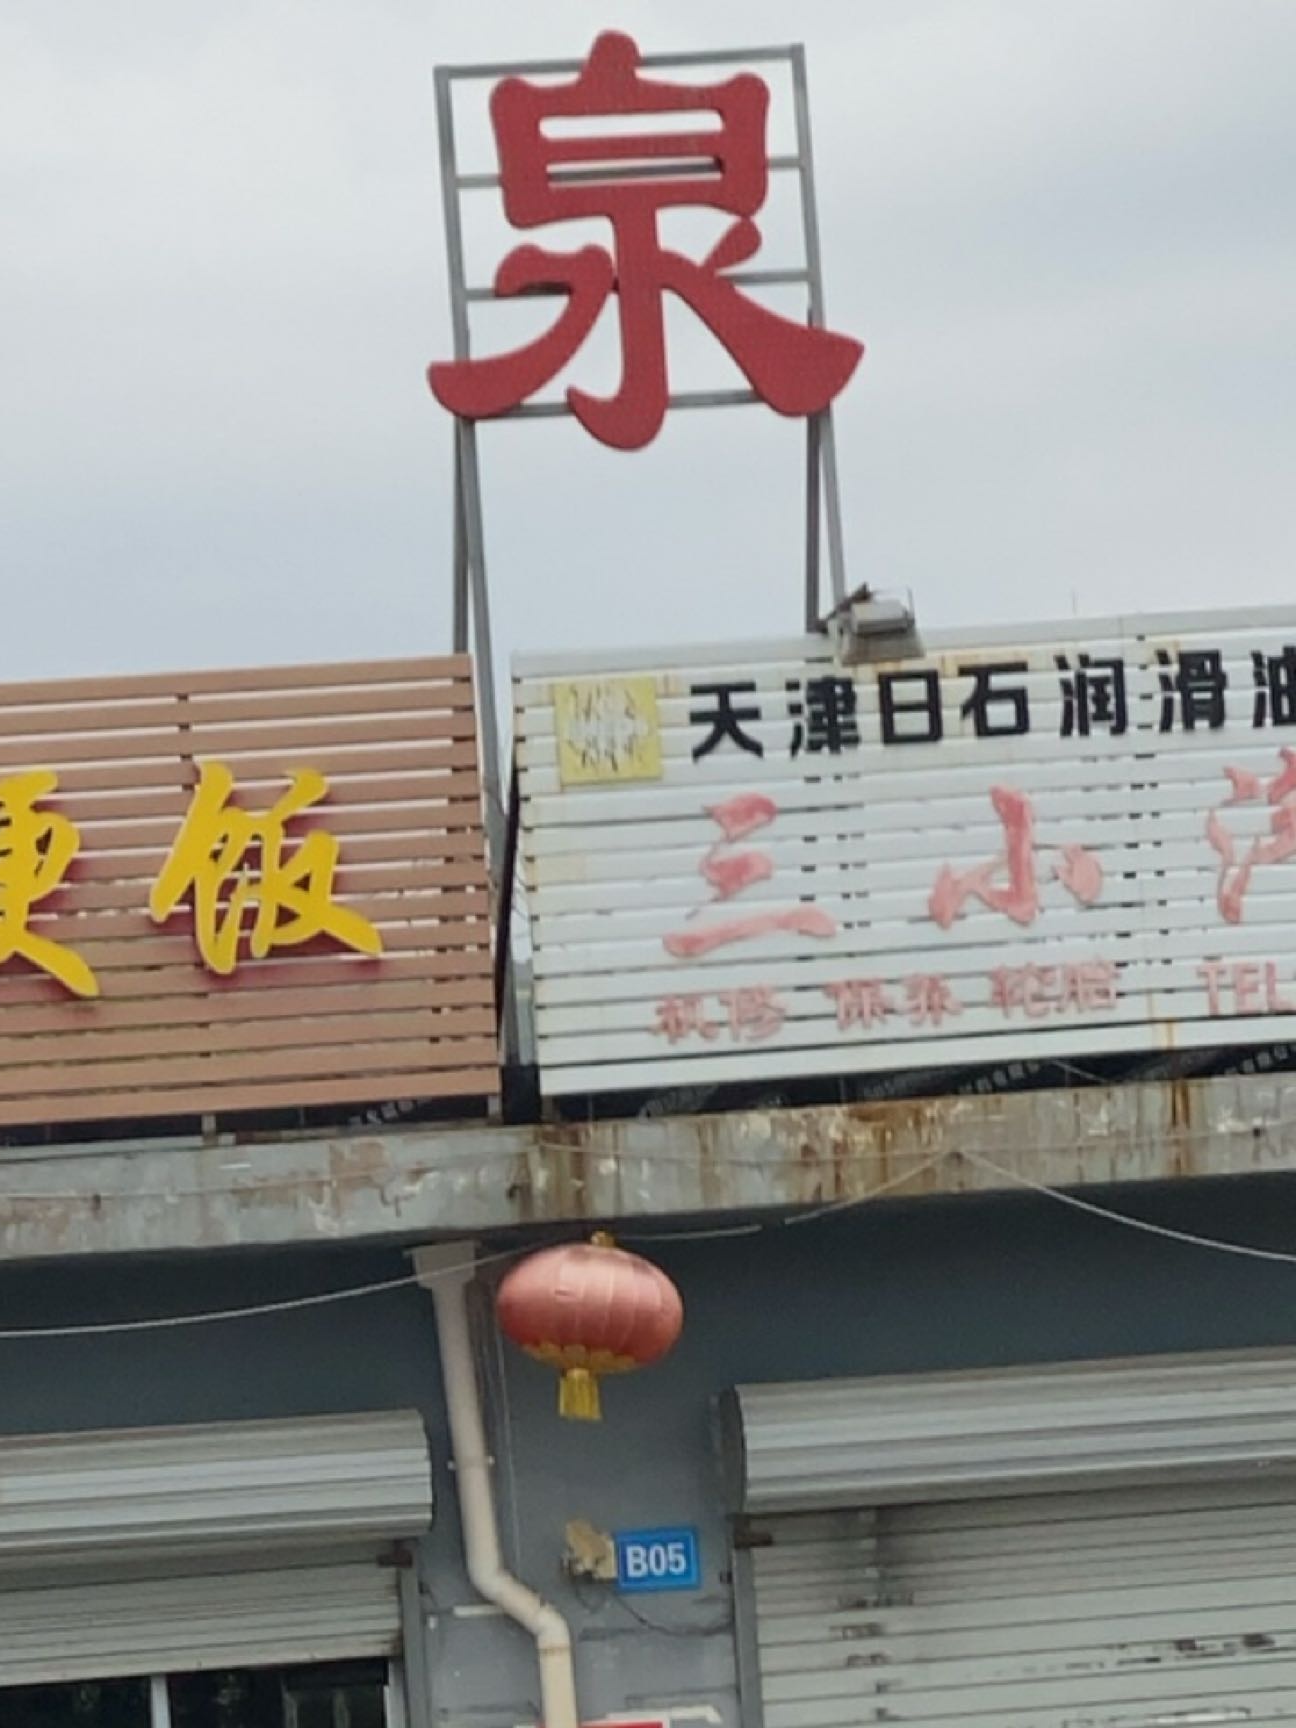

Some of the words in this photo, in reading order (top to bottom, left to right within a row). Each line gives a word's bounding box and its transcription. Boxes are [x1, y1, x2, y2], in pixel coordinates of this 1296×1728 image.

[428, 30, 865, 451] 泉
[689, 642, 1296, 762] 天津日石润滑油
[626, 1542, 687, 1578] B05
